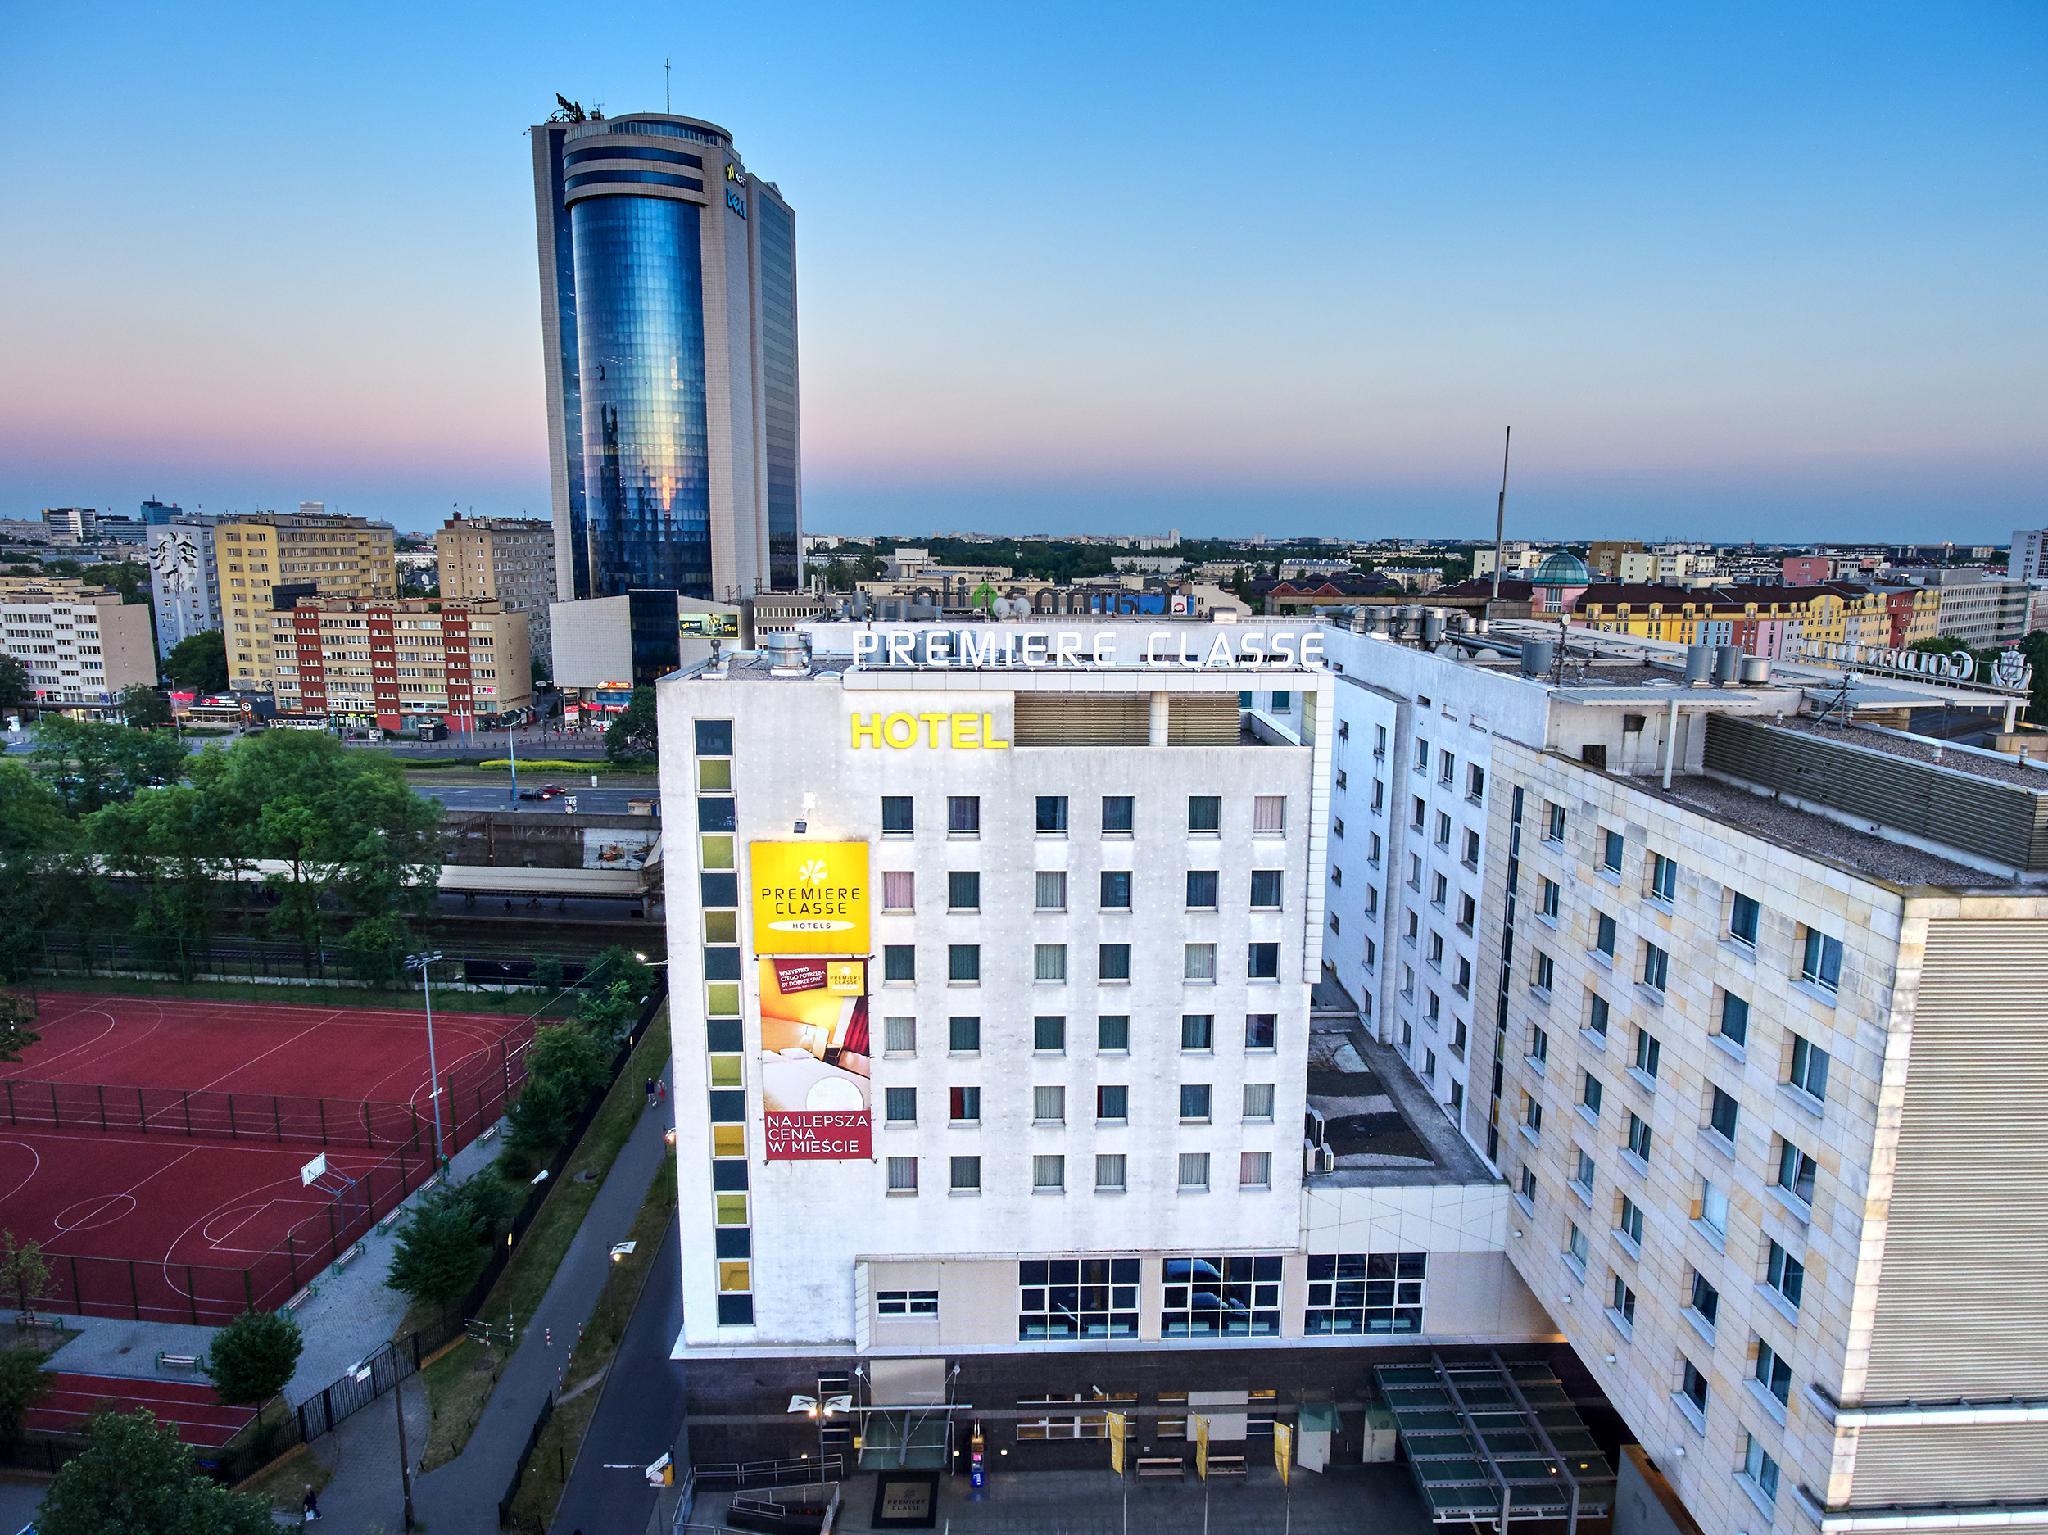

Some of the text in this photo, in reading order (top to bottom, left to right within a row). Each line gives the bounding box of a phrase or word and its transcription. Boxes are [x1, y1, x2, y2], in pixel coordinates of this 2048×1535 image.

[852, 630, 1325, 668] PREMIERE CLASSE
[851, 712, 1009, 749] HOTEL
[762, 887, 861, 900] PREMIERE
[775, 902, 847, 915] CLASSE
[792, 922, 832, 930] HOTELS
[767, 1115, 869, 1128] NAJLEPSZA
[767, 1128, 816, 1140] CENA
[768, 1138, 860, 1153] W MIEŚCIE
